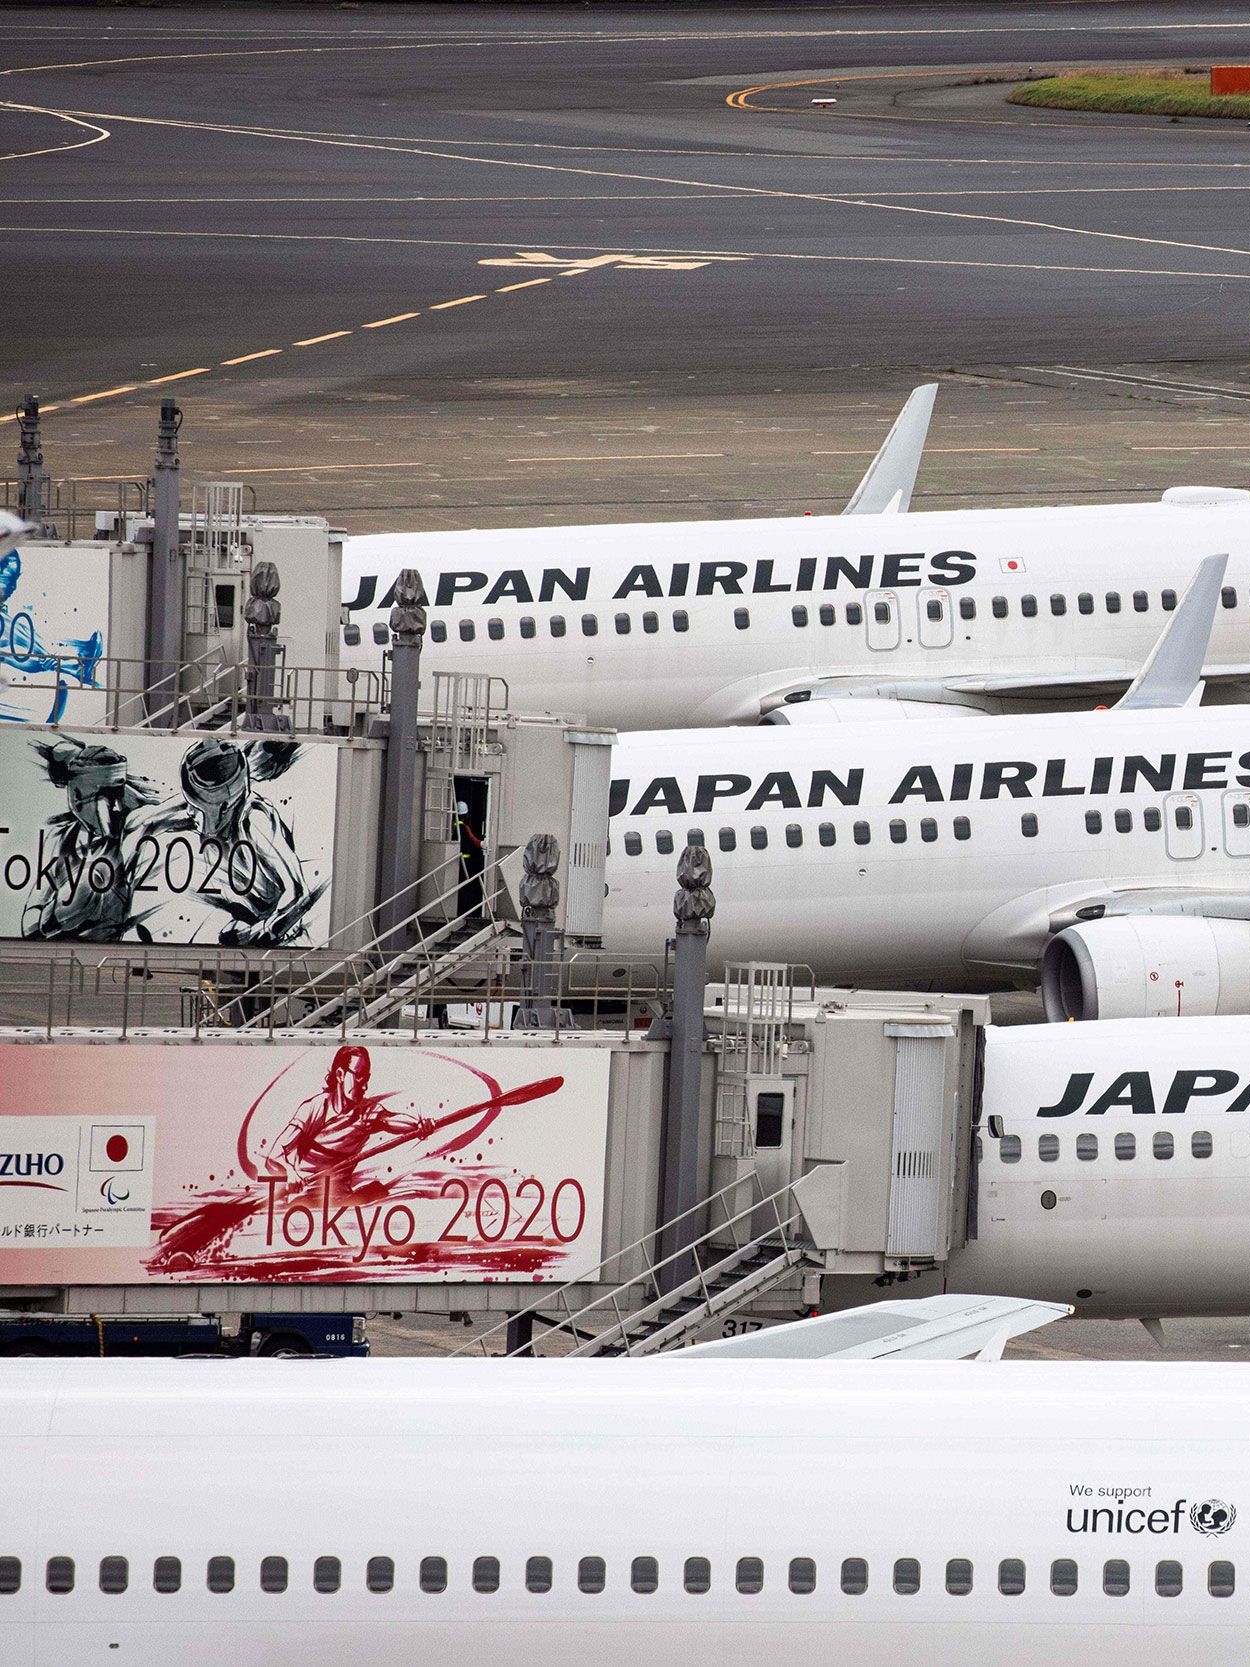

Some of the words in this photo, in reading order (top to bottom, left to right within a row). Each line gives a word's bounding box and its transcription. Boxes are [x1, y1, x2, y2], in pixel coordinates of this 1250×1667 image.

[612, 550, 977, 599] AIRLINES
[609, 768, 864, 818] JAPAN
[134, 836, 257, 896] 2020
[257, 1176, 416, 1263] Tokyo
[438, 1178, 586, 1243] 2020
[1066, 1498, 1187, 1534] unicef
[1069, 1484, 1094, 1497] We
[1097, 1485, 1152, 1502] support
